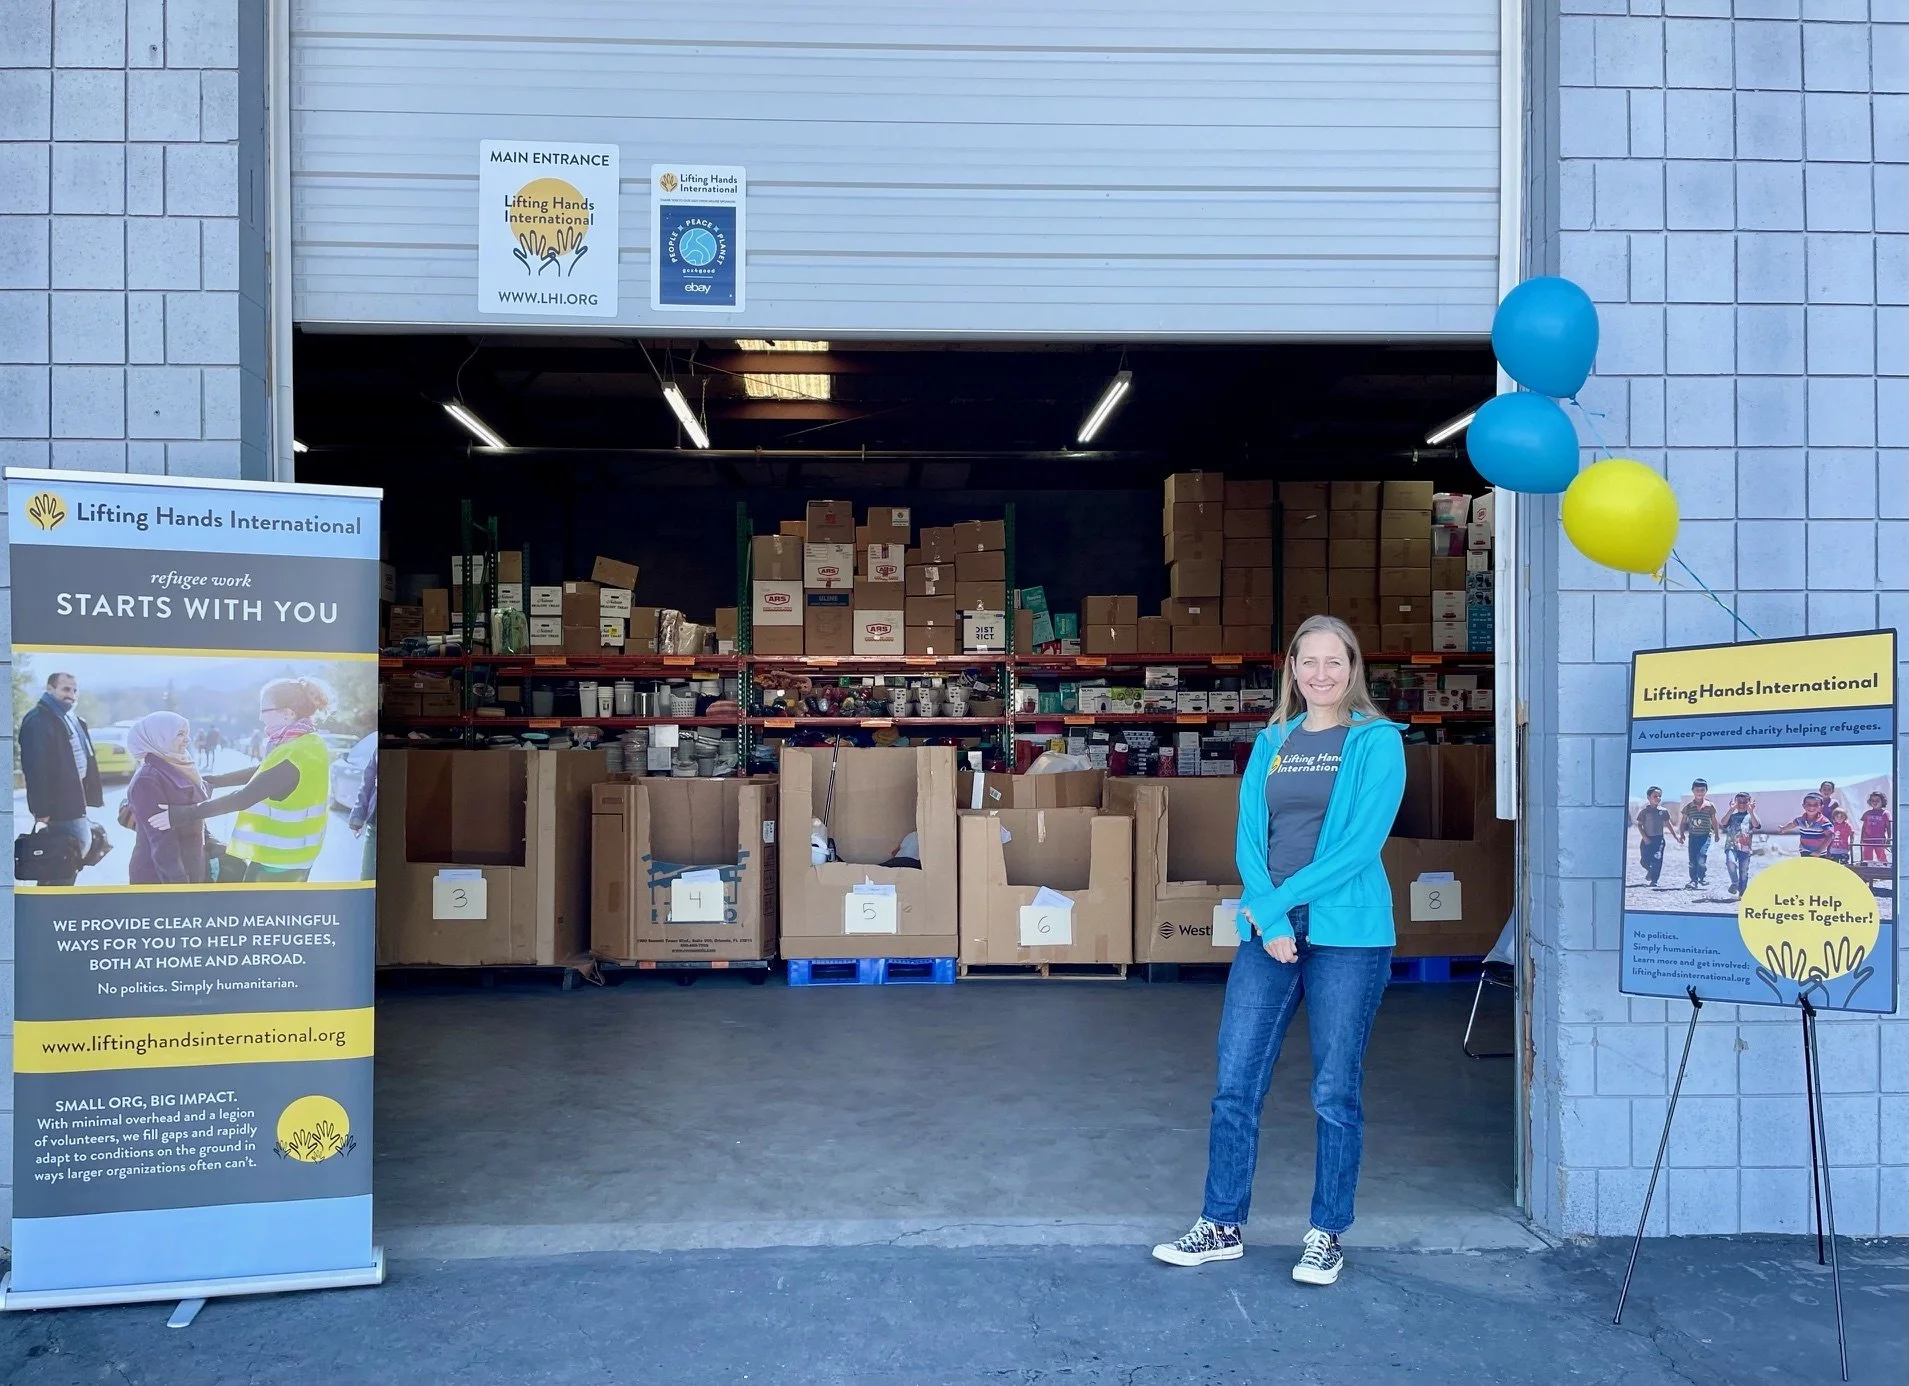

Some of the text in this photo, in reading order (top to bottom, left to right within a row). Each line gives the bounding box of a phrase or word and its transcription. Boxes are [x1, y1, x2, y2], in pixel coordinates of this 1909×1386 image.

[490, 151, 610, 167] MAIN ENTRANCE
[680, 173, 738, 186] Lifting Hands
[680, 184, 738, 194] International
[504, 195, 595, 212] Lifting Hands
[504, 210, 594, 226] International
[668, 218, 726, 266] PEOPLE PEACE PLANET
[684, 282, 711, 294] ebay
[498, 291, 598, 306] WWW.LHI.ORG
[77, 503, 361, 535] Lifting Hands International
[150, 571, 251, 590] refugee work
[57, 593, 337, 624] STARTS WITH YOU
[1643, 672, 1878, 704] Lifting Hands International
[1638, 721, 1881, 740] A volunteer-powered charity helping refugees.
[1277, 763, 1339, 773] Internation
[1282, 753, 1342, 765] Lifting Han
[453, 888, 468, 908] 3
[690, 891, 702, 909] 4
[1429, 891, 1442, 910] 8
[1809, 895, 1842, 910] Help
[862, 902, 877, 920] 5
[1745, 908, 1874, 926] Refugees Together!
[53, 914, 340, 932] WE PROVIDE CLEAR AND MEANINGFUL
[1037, 915, 1051, 934] 6
[1179, 924, 1213, 936] West
[57, 933, 336, 952] WAYS FOR YOU TO HELP REFUGEES,
[1633, 930, 1679, 940] No politics.
[1633, 943, 1721, 955] Simply humanitarian.
[90, 953, 306, 971] BOTH AT HOME AND ABROAD.
[1633, 955, 1655, 963] Learn
[1697, 961, 1710, 969] get
[1712, 960, 1750, 970] involved:
[1632, 967, 1751, 985] liftinghandsinternational.org
[98, 978, 298, 997] No politics. Simply humanitarian.
[42, 1027, 346, 1055] www.liftinghandsinternational.org
[55, 1091, 238, 1112] SMALL ORG, BIG IMPACT.
[37, 1108, 255, 1130] With minimal overhead and a legion
[34, 1124, 258, 1148] of volunteers, we fill gaps and rapidly
[35, 1140, 256, 1166] adapt to conditions on the ground in
[34, 1171, 65, 1184] ways
[67, 1166, 103, 1182] larger
[106, 1162, 186, 1178] organizations
[189, 1158, 222, 1171] often
